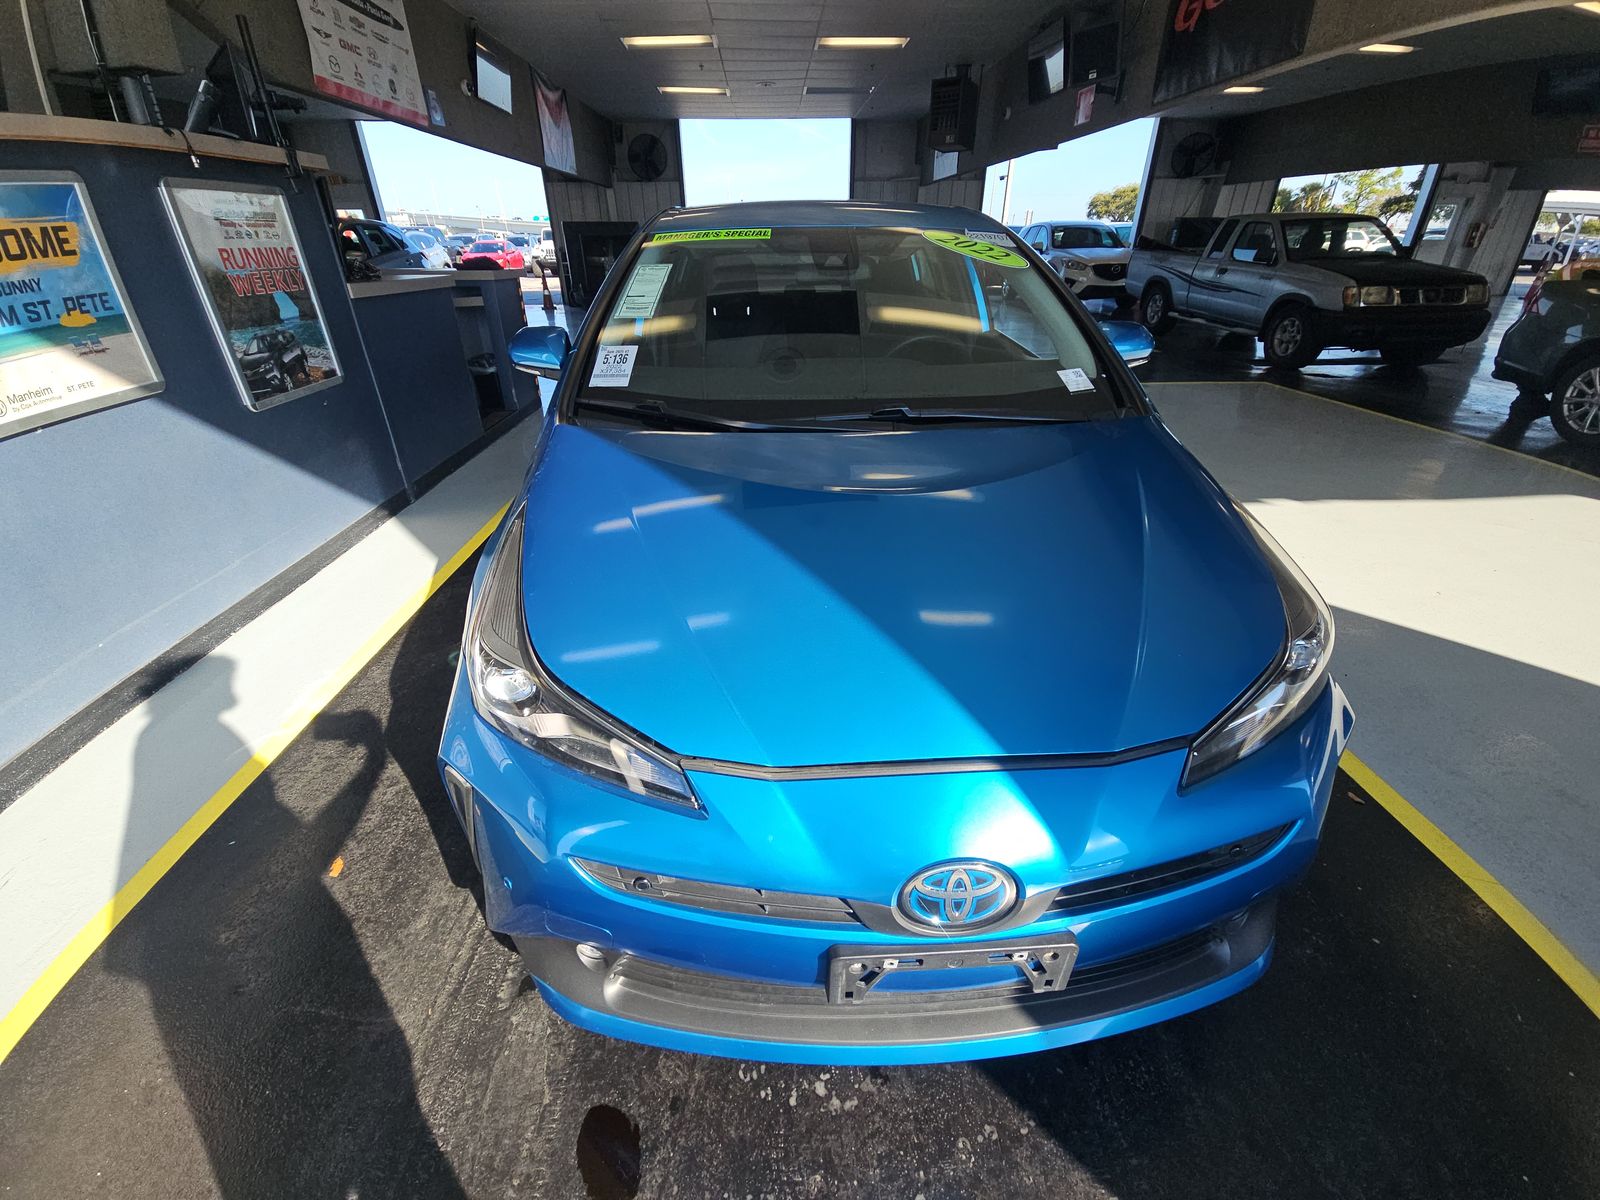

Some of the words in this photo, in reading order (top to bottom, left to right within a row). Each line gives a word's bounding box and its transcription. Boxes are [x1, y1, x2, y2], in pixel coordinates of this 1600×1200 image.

[338, 38, 363, 57] GMC
[0, 225, 78, 262] OME
[656, 231, 721, 241] MANAGER'S
[723, 228, 770, 238] SPECIAL
[217, 246, 300, 271] RUNNING
[935, 236, 1011, 260] 2022
[226, 269, 304, 297] WEEKLY
[22, 299, 60, 323] ST.
[62, 292, 114, 316] PETE
[602, 353, 629, 365] 5:136
[6, 386, 54, 405] Manheim
[78, 380, 96, 390] PETE
[20, 402, 32, 411] Cox
